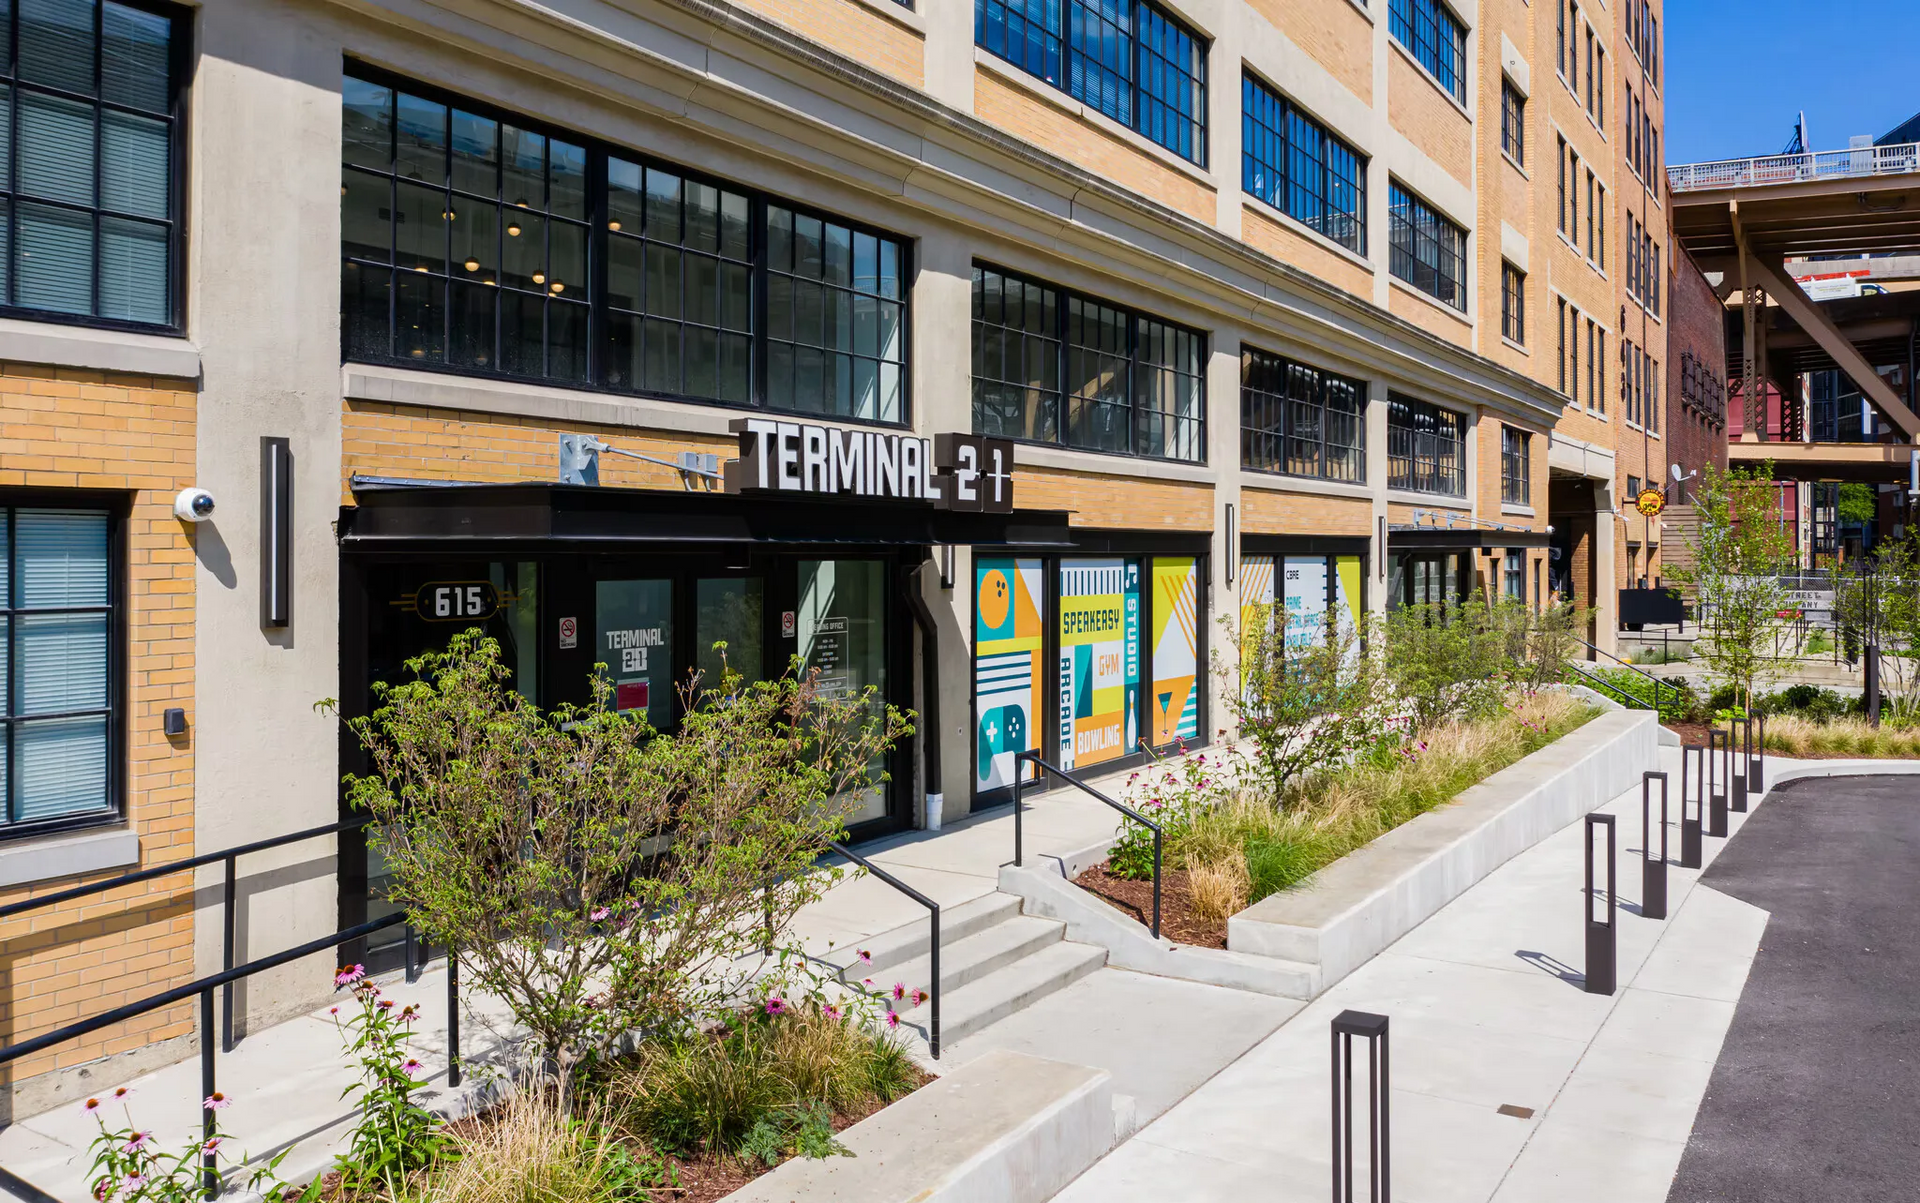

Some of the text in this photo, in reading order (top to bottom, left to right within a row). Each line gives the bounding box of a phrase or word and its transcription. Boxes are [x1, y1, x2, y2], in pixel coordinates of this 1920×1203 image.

[747, 418, 1003, 503] TERMINAL 21
[435, 586, 482, 617] 615
[1063, 609, 1120, 634] SPEAKEASY
[606, 628, 665, 650] TERMINAL
[1127, 598, 1136, 677] STUDIO
[624, 649, 645, 671] 21
[1098, 654, 1119, 677] GYM
[1060, 657, 1071, 751] ARCADE
[1078, 724, 1119, 755] BOWLING
